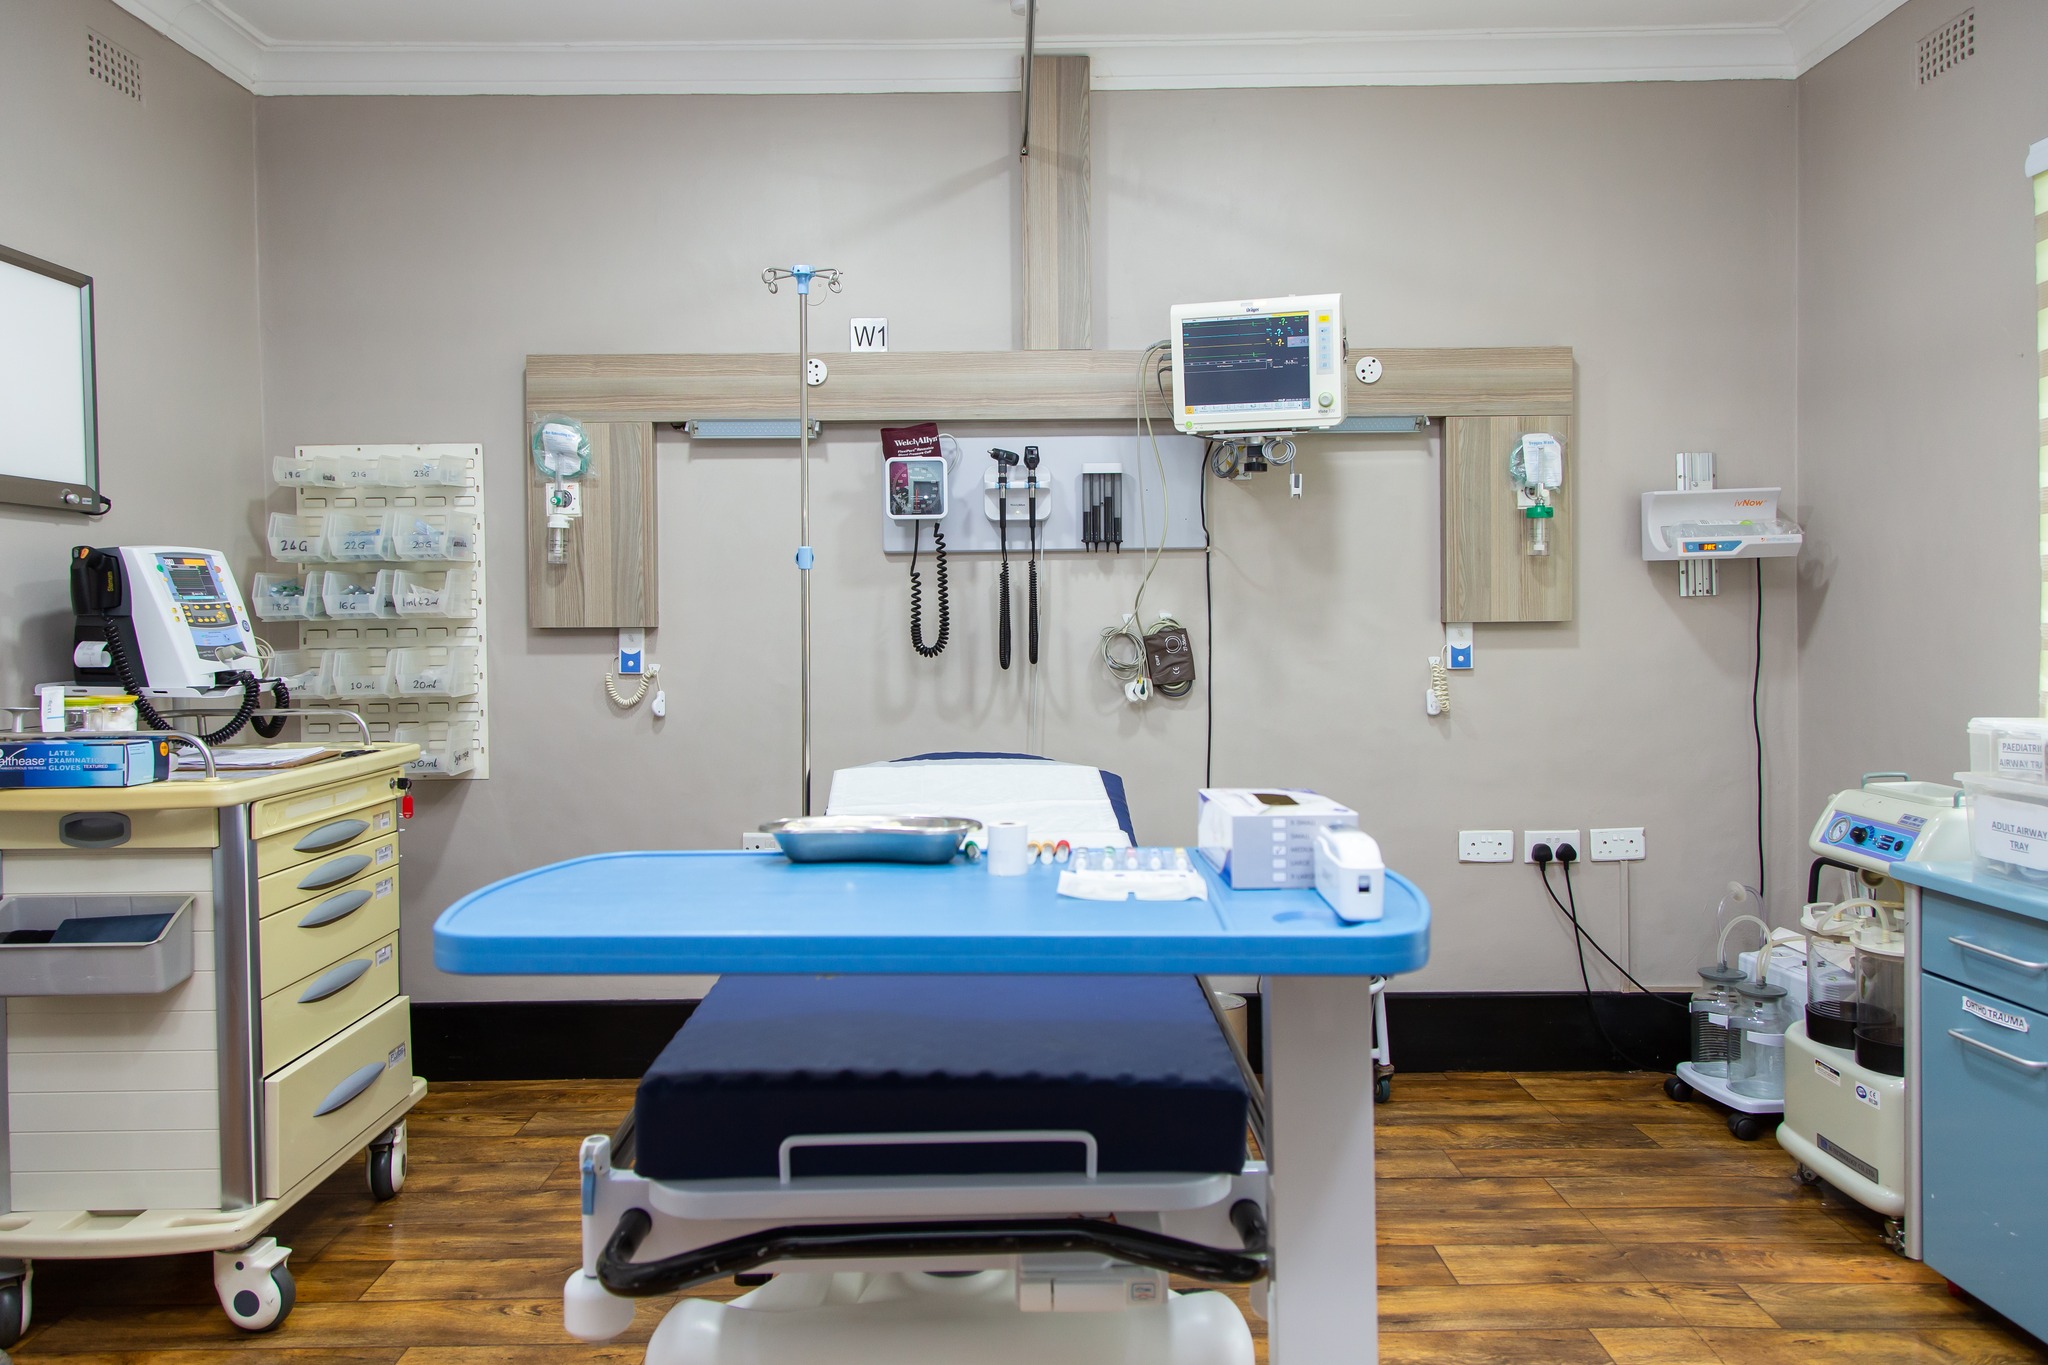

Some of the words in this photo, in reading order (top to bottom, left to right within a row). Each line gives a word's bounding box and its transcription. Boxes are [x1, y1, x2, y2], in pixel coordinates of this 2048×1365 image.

[854, 325, 886, 347] W1
[351, 470, 367, 478] 21G
[413, 470, 430, 478] 23G
[1734, 499, 1763, 507] ivNow
[280, 540, 307, 552] 24G
[344, 541, 366, 550] 22G
[412, 540, 432, 549] 20G
[272, 602, 290, 611] 18G
[339, 601, 356, 610] 16G
[413, 679, 437, 689] 20ml
[2000, 759, 2029, 768] AIRWAY
[1991, 821, 2015, 833] ADULT
[2016, 826, 2048, 840] AIRWAY
[2009, 840, 2029, 851] TRAY
[1965, 999, 1986, 1015] ORTHO
[1987, 1009, 2025, 1028] TRAUMA
